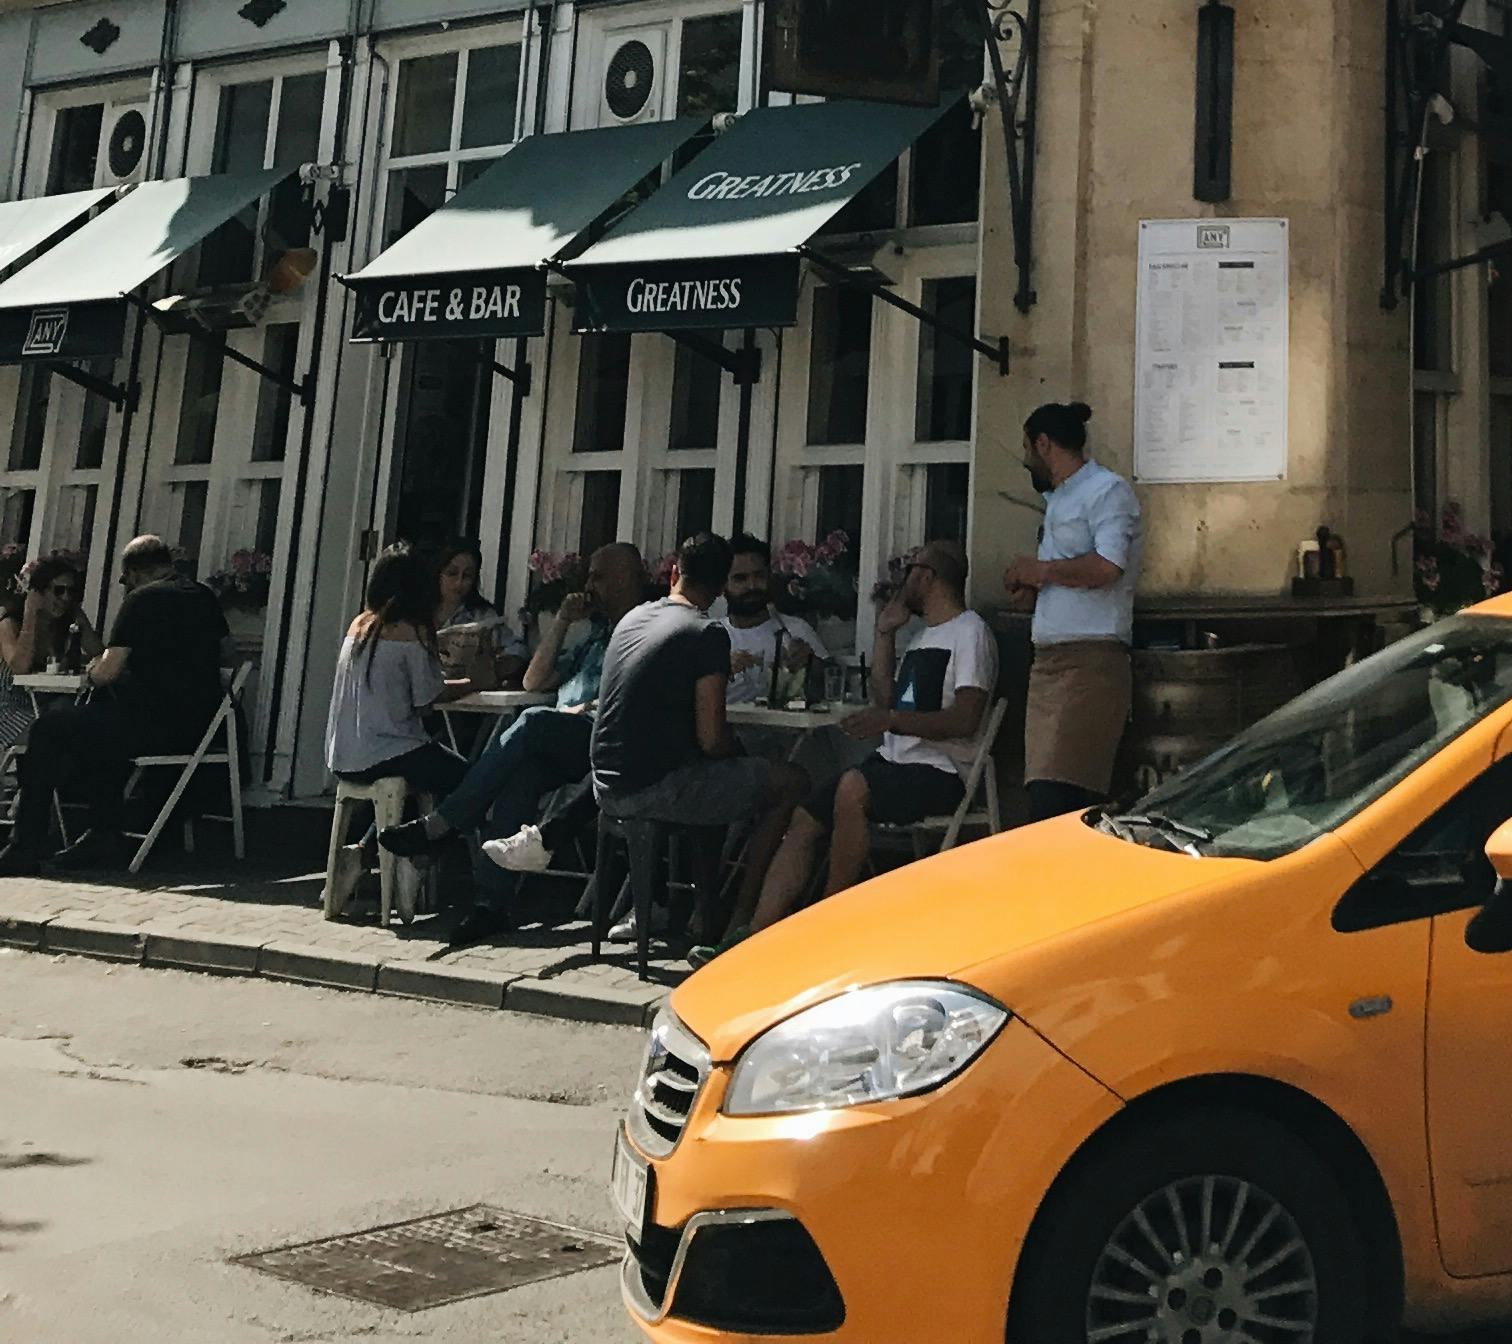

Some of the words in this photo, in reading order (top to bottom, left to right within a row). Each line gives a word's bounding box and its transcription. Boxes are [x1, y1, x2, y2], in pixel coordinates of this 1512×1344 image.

[686, 162, 862, 201] GREATNESS
[377, 288, 441, 323] CAFE
[445, 287, 464, 320] &
[468, 284, 521, 320] BAR
[626, 277, 742, 313] GREATNESS
